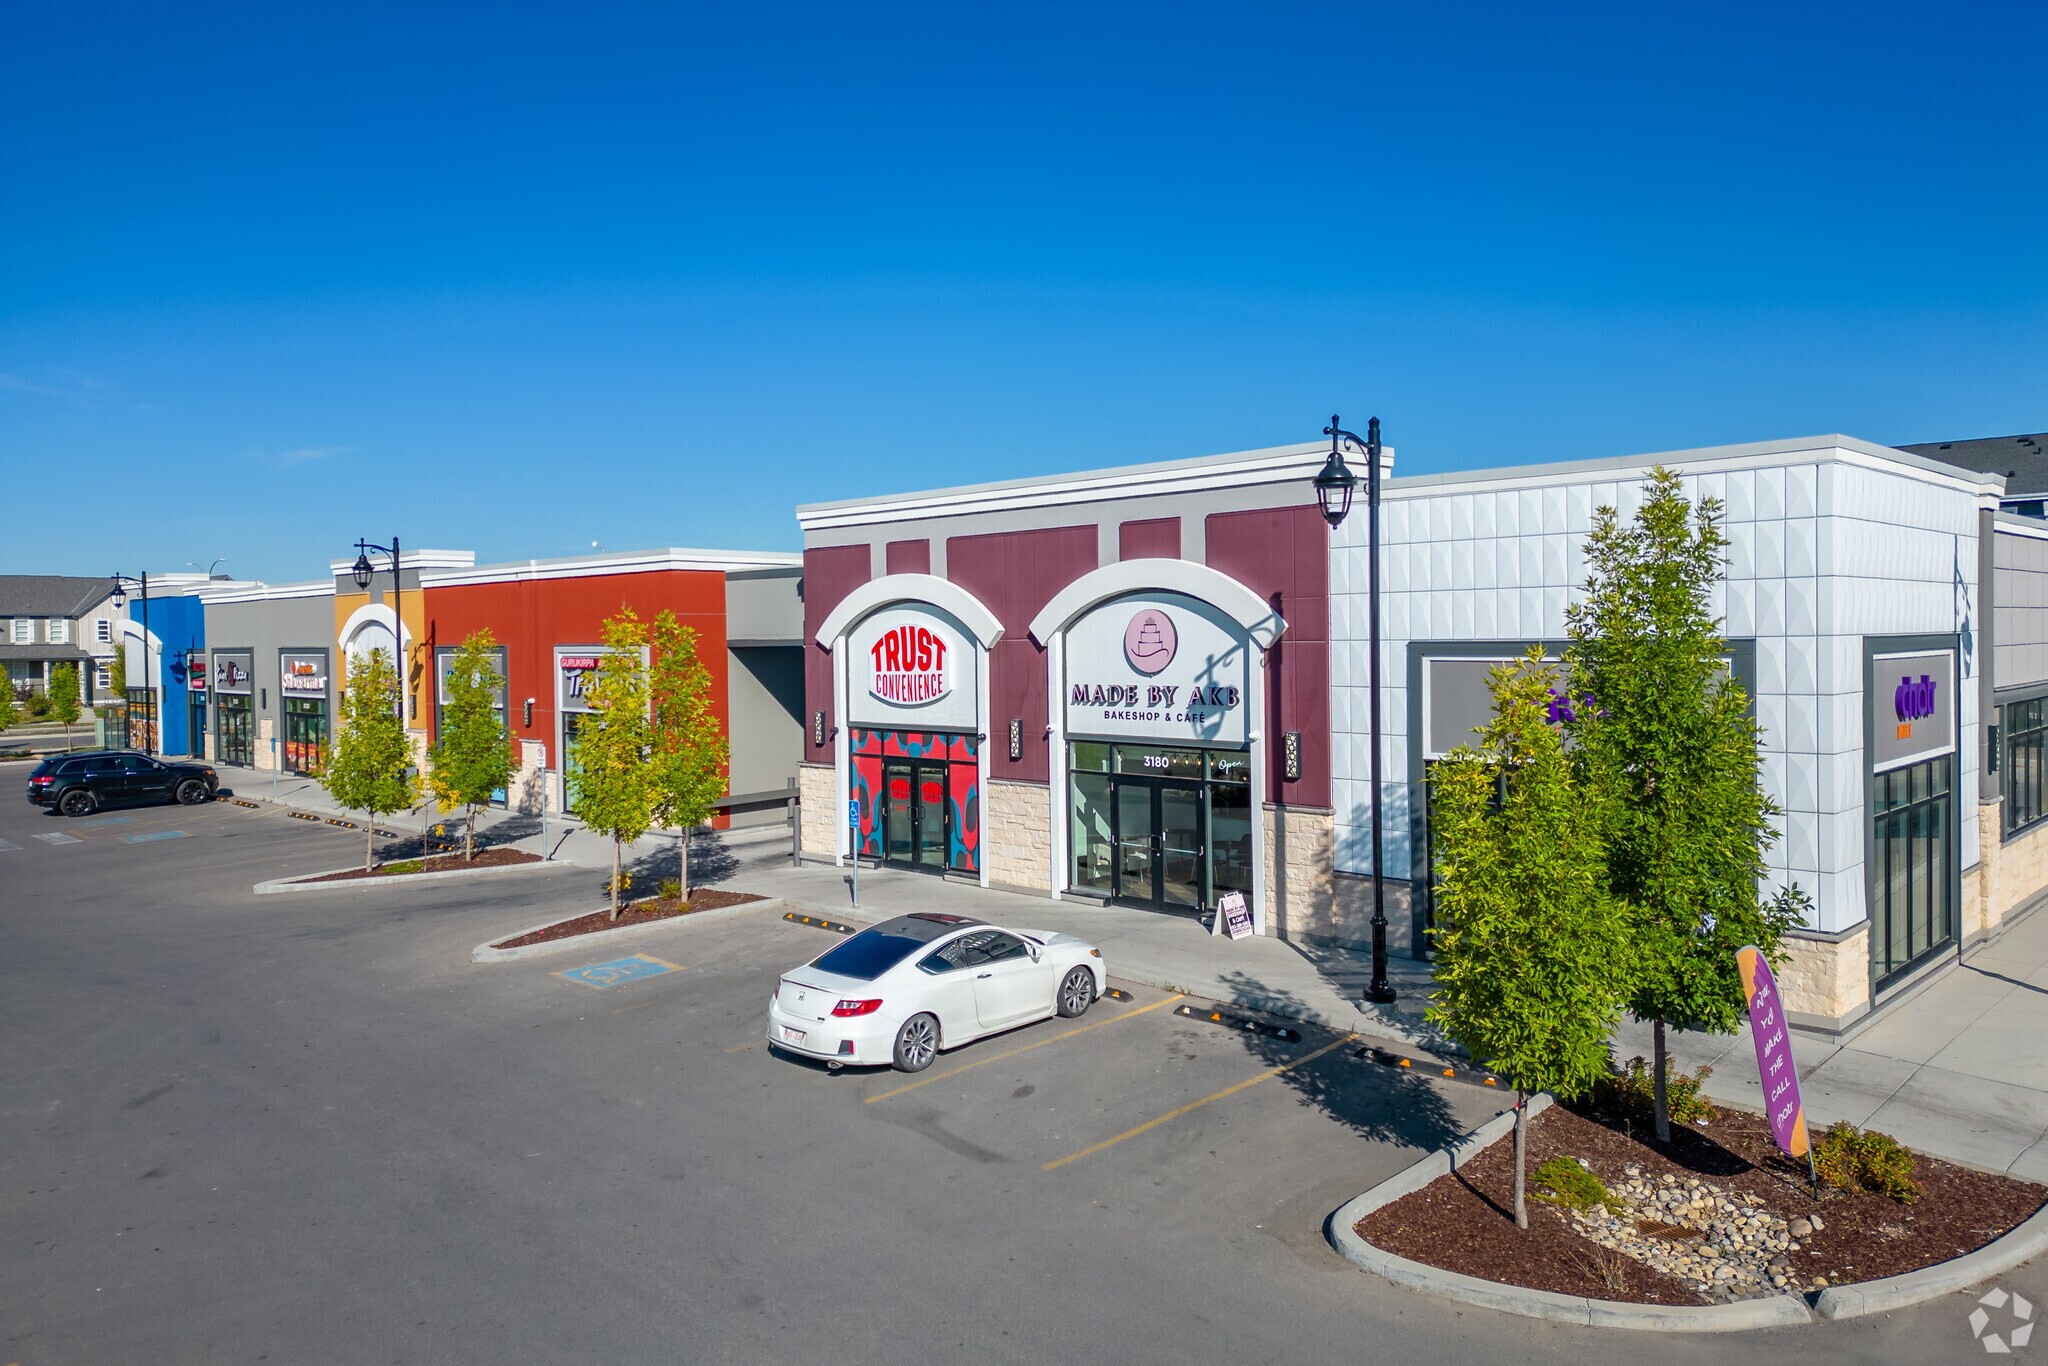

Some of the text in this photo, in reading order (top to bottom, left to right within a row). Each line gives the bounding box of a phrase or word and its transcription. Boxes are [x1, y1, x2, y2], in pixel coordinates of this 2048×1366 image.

[871, 626, 946, 672] TRUST
[561, 658, 595, 668] GURUKIRPA
[876, 673, 943, 702] CONVENIENCE
[1071, 684, 1240, 708] MADE BY AKB
[1104, 711, 1205, 723] BAKESHOP & CAFÉ
[1144, 755, 1169, 768] 3180
[1218, 757, 1244, 775] Open
[1769, 1054, 1784, 1077] THE
[1771, 1077, 1790, 1102] CALL
